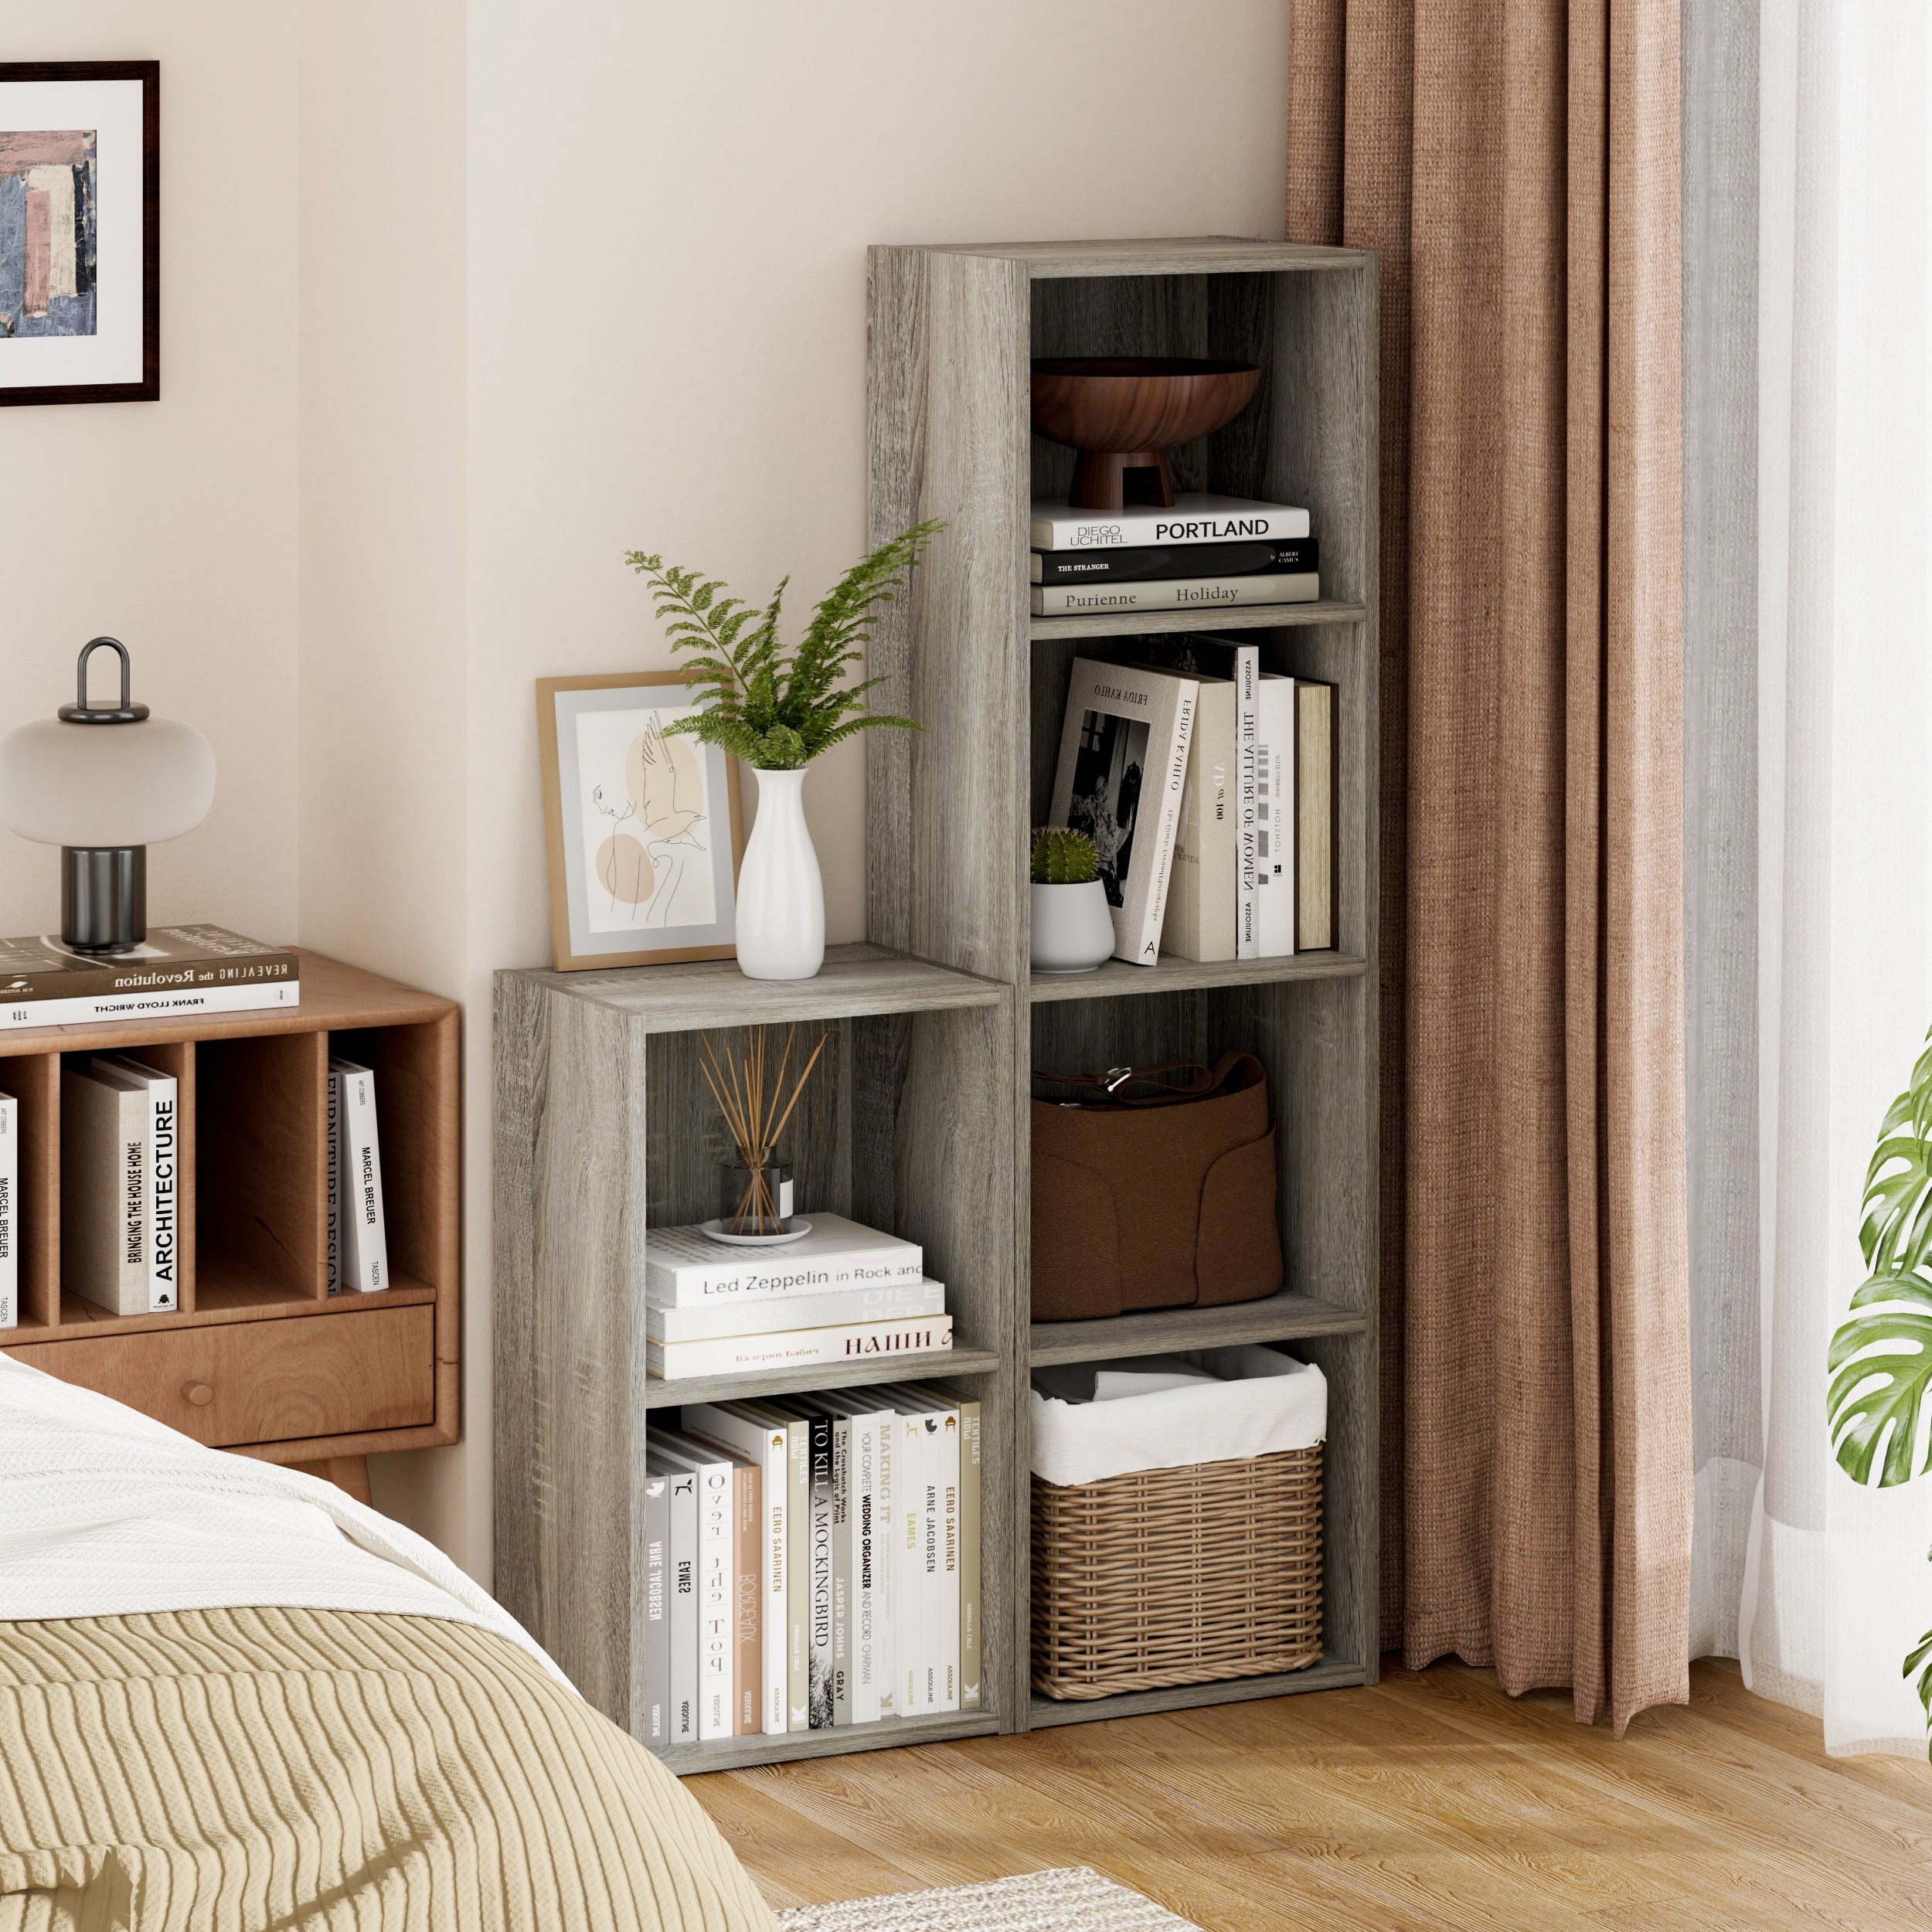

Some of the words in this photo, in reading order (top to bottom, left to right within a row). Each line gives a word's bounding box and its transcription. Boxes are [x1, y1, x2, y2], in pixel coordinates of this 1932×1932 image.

[1070, 535, 1128, 546] UCHITEL
[1078, 526, 1121, 536] DIEGO
[1156, 519, 1269, 539] PORTLAND
[1066, 594, 1138, 607] Purienne
[1176, 587, 1238, 601] Holiday
[1145, 941, 1155, 955] A
[128, 1141, 141, 1167] HOME
[362, 1147, 373, 1185] MARCEL
[128, 1169, 141, 1199] HOUSE
[155, 1100, 172, 1281] ARCHITECTURE
[128, 1200, 141, 1218] THE
[365, 1186, 376, 1225] BREUER
[128, 1219, 141, 1264] BRINGING
[704, 1278, 739, 1294] Led
[747, 1270, 829, 1291] Zeppelin
[836, 1270, 849, 1281] in
[855, 1266, 891, 1281] Rock
[815, 1420, 828, 1447] TO
[862, 1431, 872, 1453] YOUR
[815, 1453, 828, 1492] KILL
[862, 1454, 872, 1492] COMPLETE
[879, 1423, 890, 1500] MAKING
[815, 1496, 828, 1508] A
[927, 1485, 935, 1513] ARNE
[946, 1486, 954, 1513] EERO
[773, 1506, 782, 1533] EERO
[862, 1495, 872, 1536] WEDDING
[879, 1505, 890, 1523] IT
[906, 1513, 916, 1549] EAMES
[927, 1518, 935, 1573] JACOBSEN
[946, 1518, 954, 1571] SAARINEN
[773, 1538, 782, 1592] SAARINEN
[862, 1538, 872, 1589] ORGANIZER
[815, 1512, 828, 1648] MOCKINGBIRD
[862, 1591, 872, 1609] AND
[862, 1610, 872, 1641] RECORD
[862, 1645, 872, 1685] CHAPMAN
